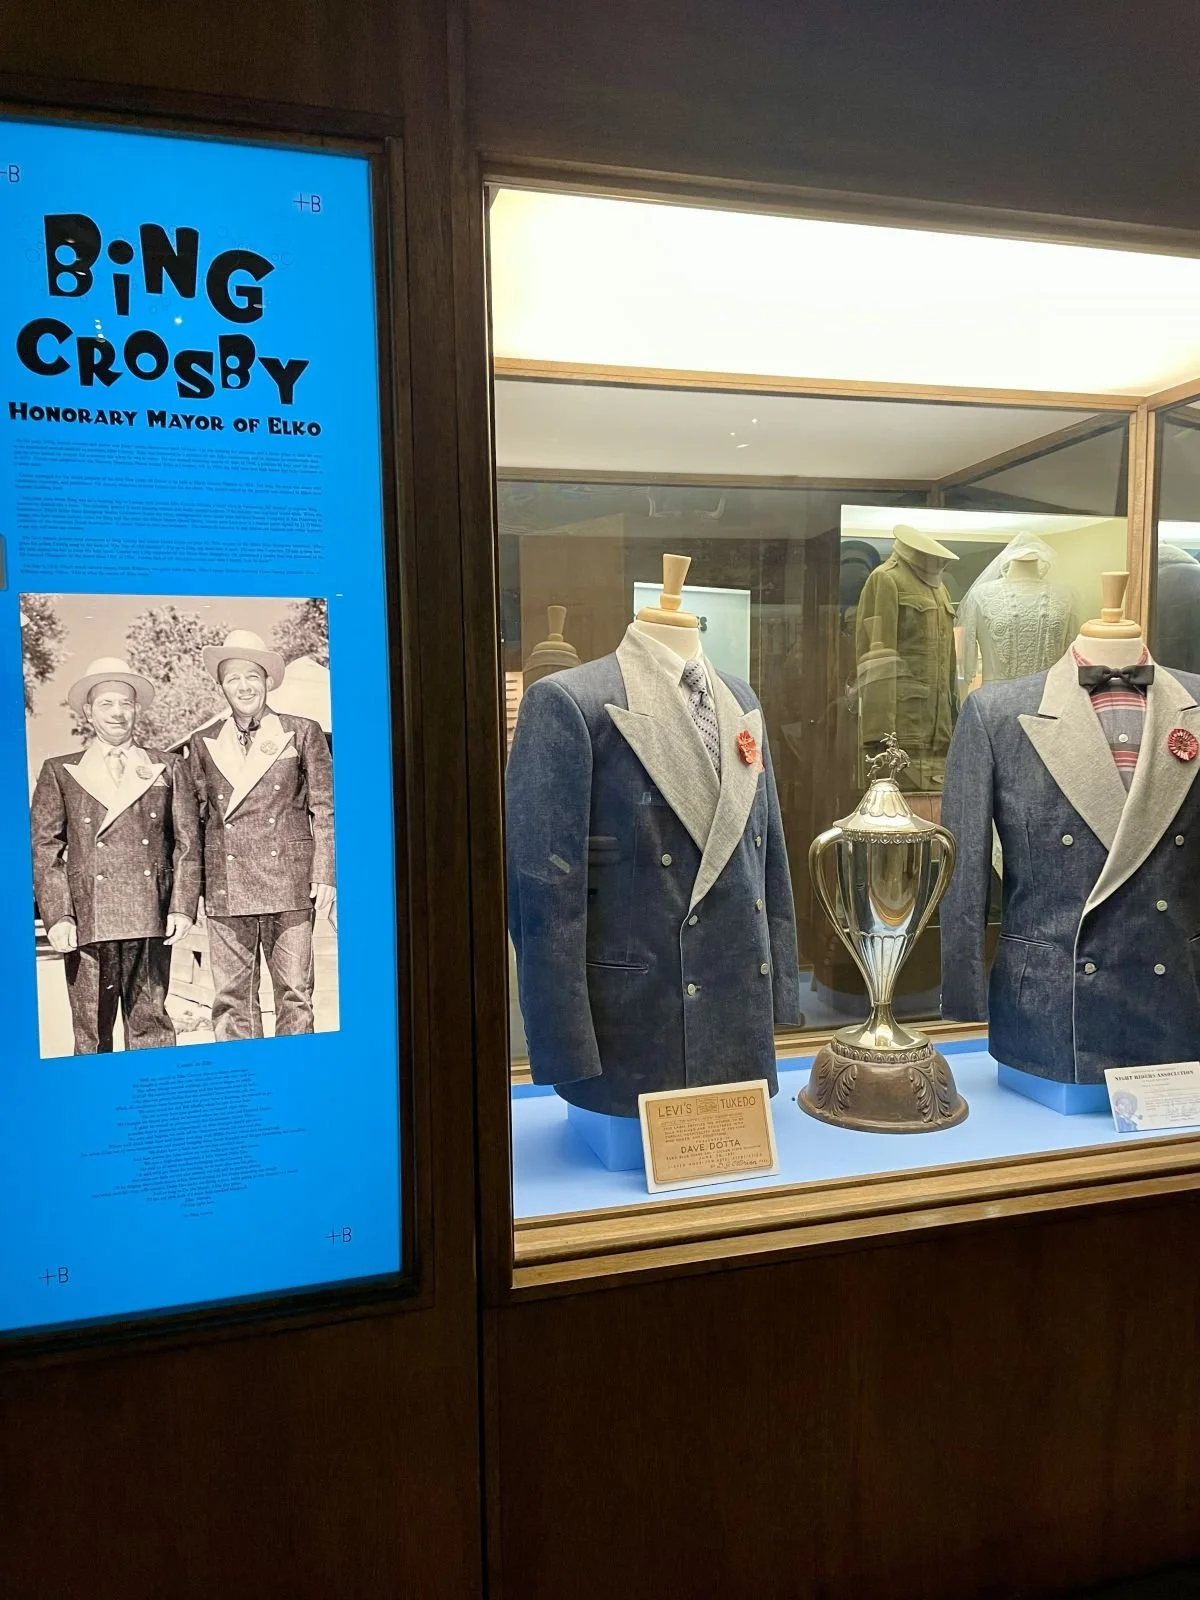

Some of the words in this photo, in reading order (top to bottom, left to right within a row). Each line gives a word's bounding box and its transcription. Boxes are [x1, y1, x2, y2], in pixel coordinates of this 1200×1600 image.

[16, 317, 310, 405] CROSBY
[8, 401, 138, 426] HONORARY
[147, 409, 224, 431] MAYOR
[233, 417, 260, 433] OF
[267, 417, 322, 437] ELKO
[658, 1103, 692, 1118] LEVI'S
[720, 1096, 756, 1109] TUXEDO
[681, 1143, 705, 1154] DAVE
[709, 1139, 741, 1150] DOTTA
